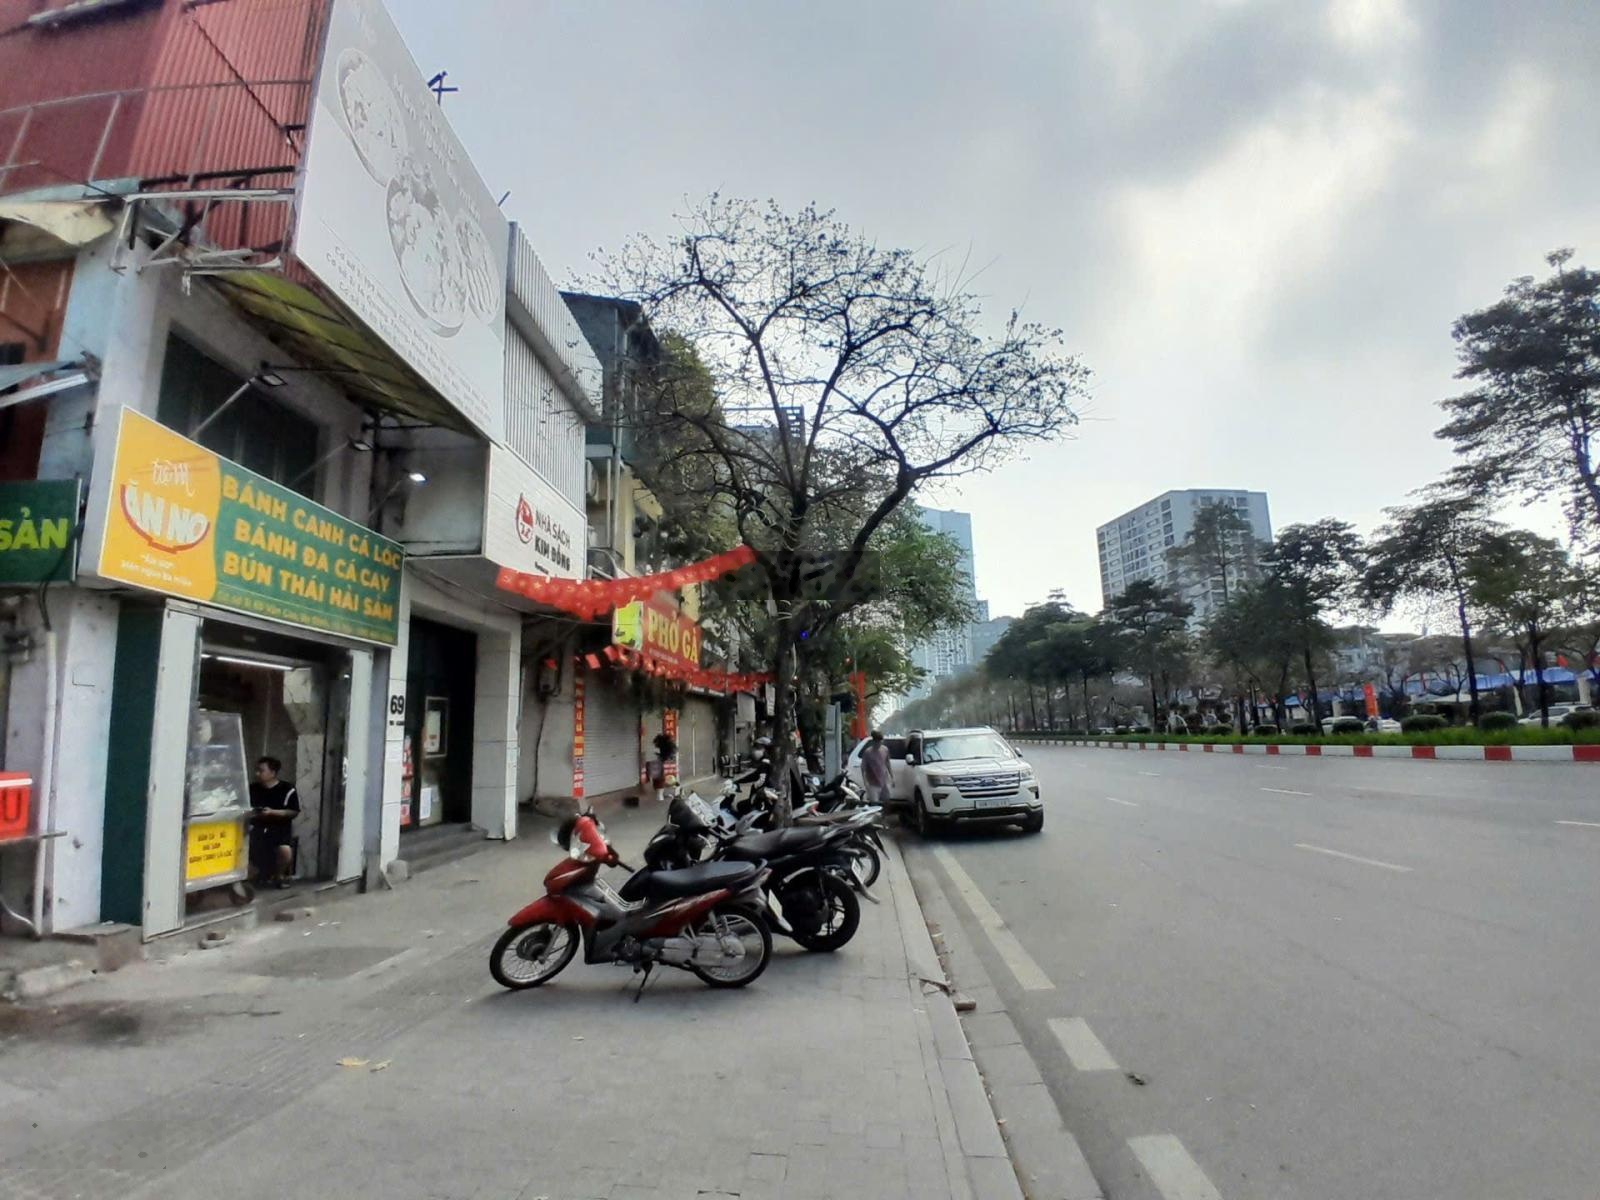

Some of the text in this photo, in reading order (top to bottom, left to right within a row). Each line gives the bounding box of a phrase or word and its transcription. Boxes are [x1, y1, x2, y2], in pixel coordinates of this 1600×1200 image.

[0, 506, 68, 551] SẢN
[222, 474, 288, 523] BÁNH
[293, 508, 344, 547] CANH
[349, 533, 370, 558] CÁ
[535, 509, 570, 549] NHÀ SÁCH
[234, 517, 391, 592] BÁNH ĐA CÁ CAY
[534, 534, 550, 560] KIM
[223, 549, 272, 587] BÚN
[280, 568, 326, 602] THÁI
[647, 607, 700, 665] PHỞ GÀ
[390, 694, 404, 715] 69
